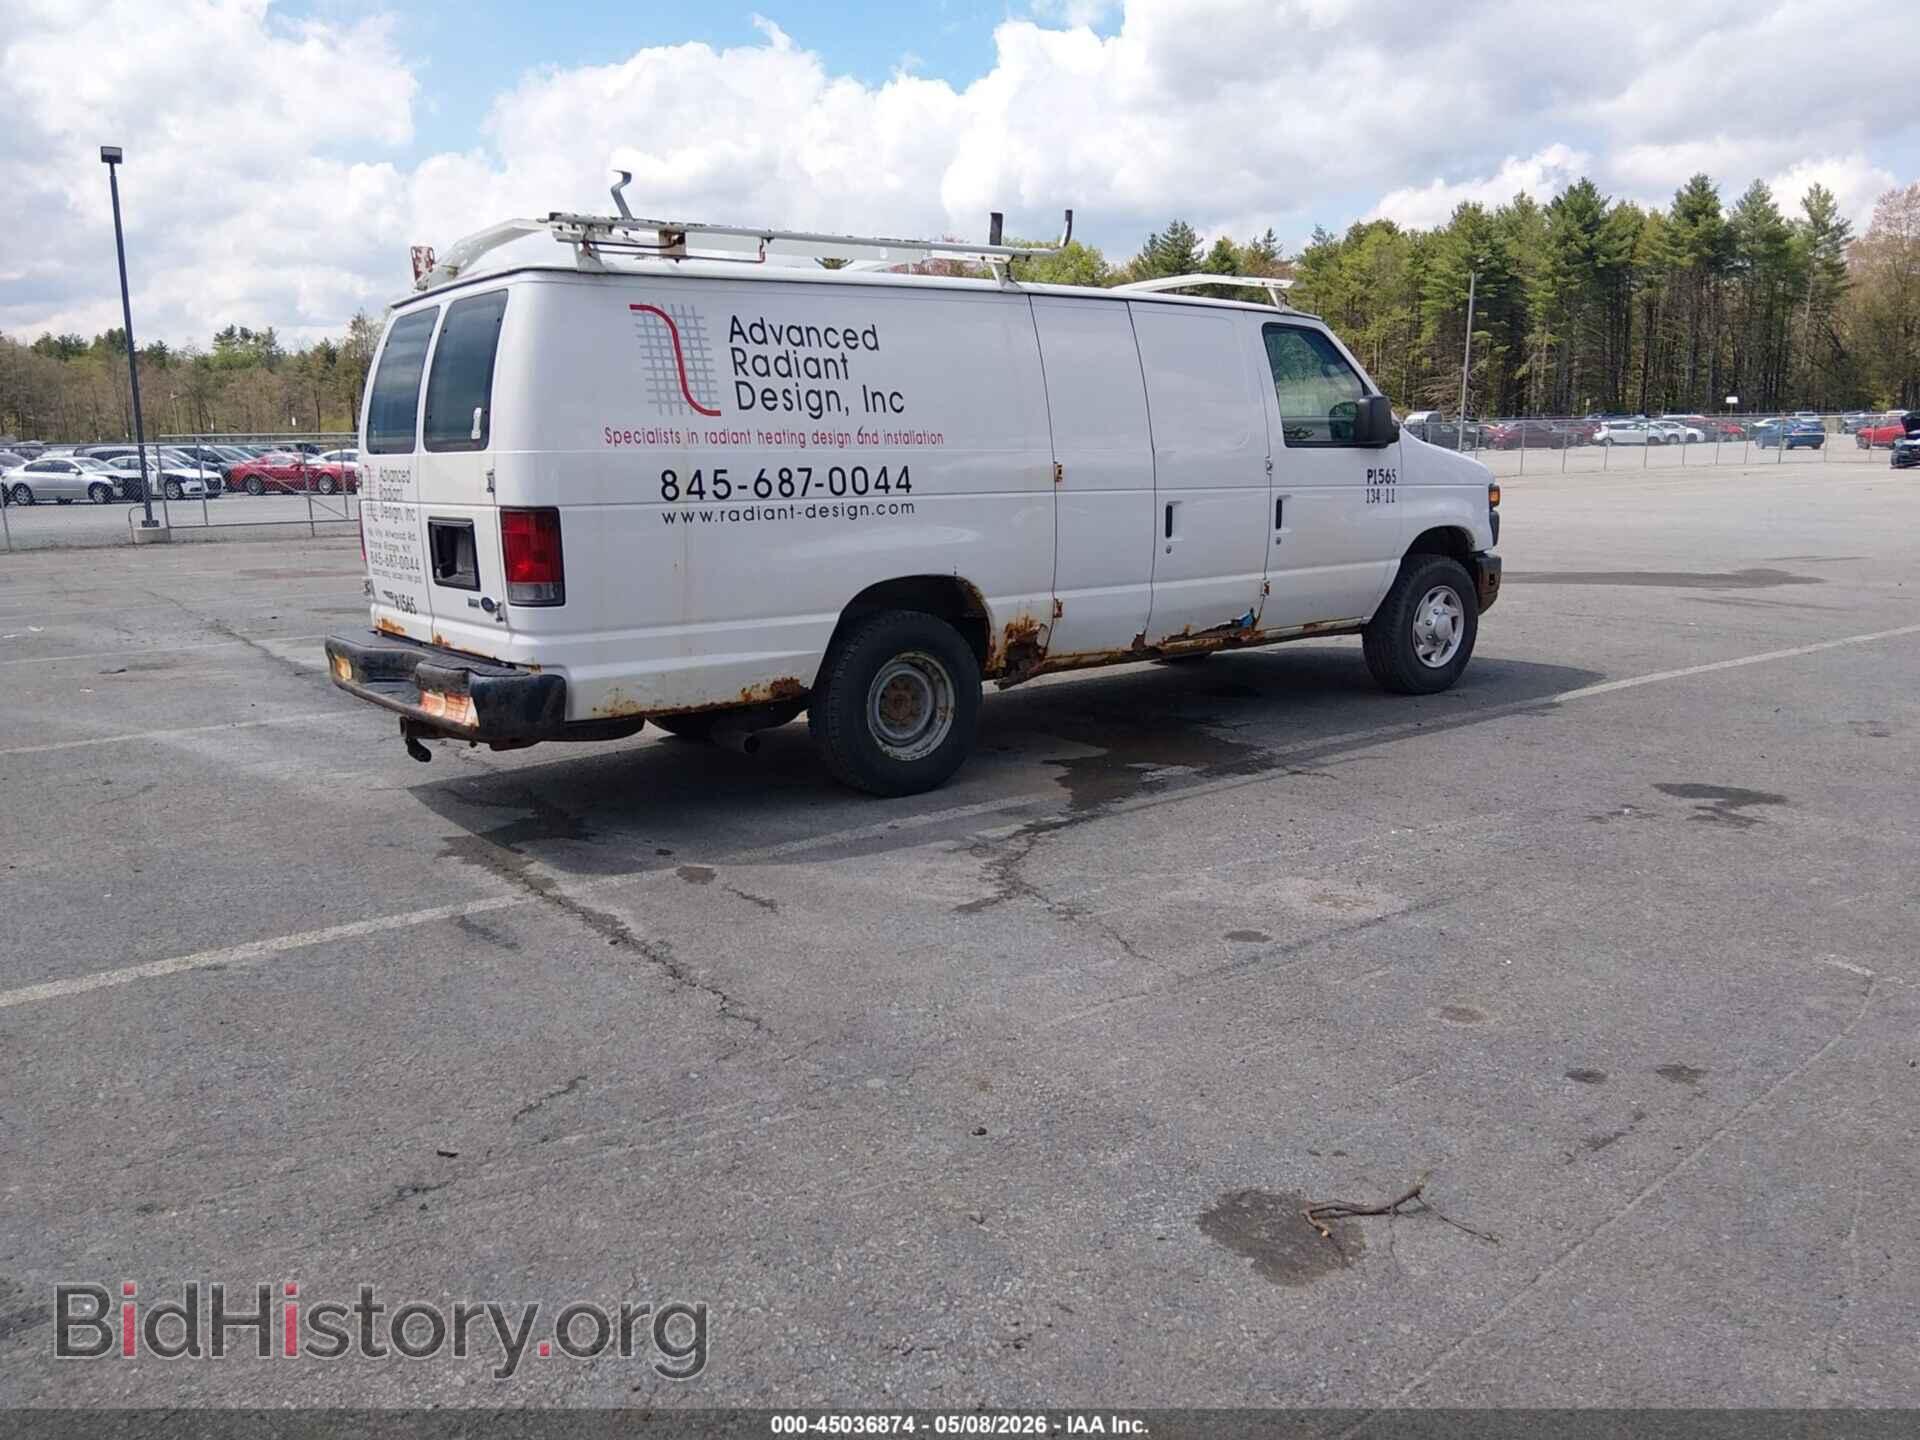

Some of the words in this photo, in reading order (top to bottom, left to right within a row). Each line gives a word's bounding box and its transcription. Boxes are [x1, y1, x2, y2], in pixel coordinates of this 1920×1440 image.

[729, 314, 880, 351] Advanced
[731, 347, 849, 380] Radiant
[735, 381, 849, 419] Design,
[862, 384, 905, 413] Inc
[604, 426, 681, 447] Specialists
[687, 428, 698, 444] in
[704, 428, 751, 445] radiant
[757, 429, 806, 448] heating
[811, 429, 851, 448] design
[883, 429, 944, 446] installation
[660, 465, 913, 501] 845-687-0044
[1367, 468, 1397, 485] P1565
[662, 501, 915, 525] www.radiant-design.com
